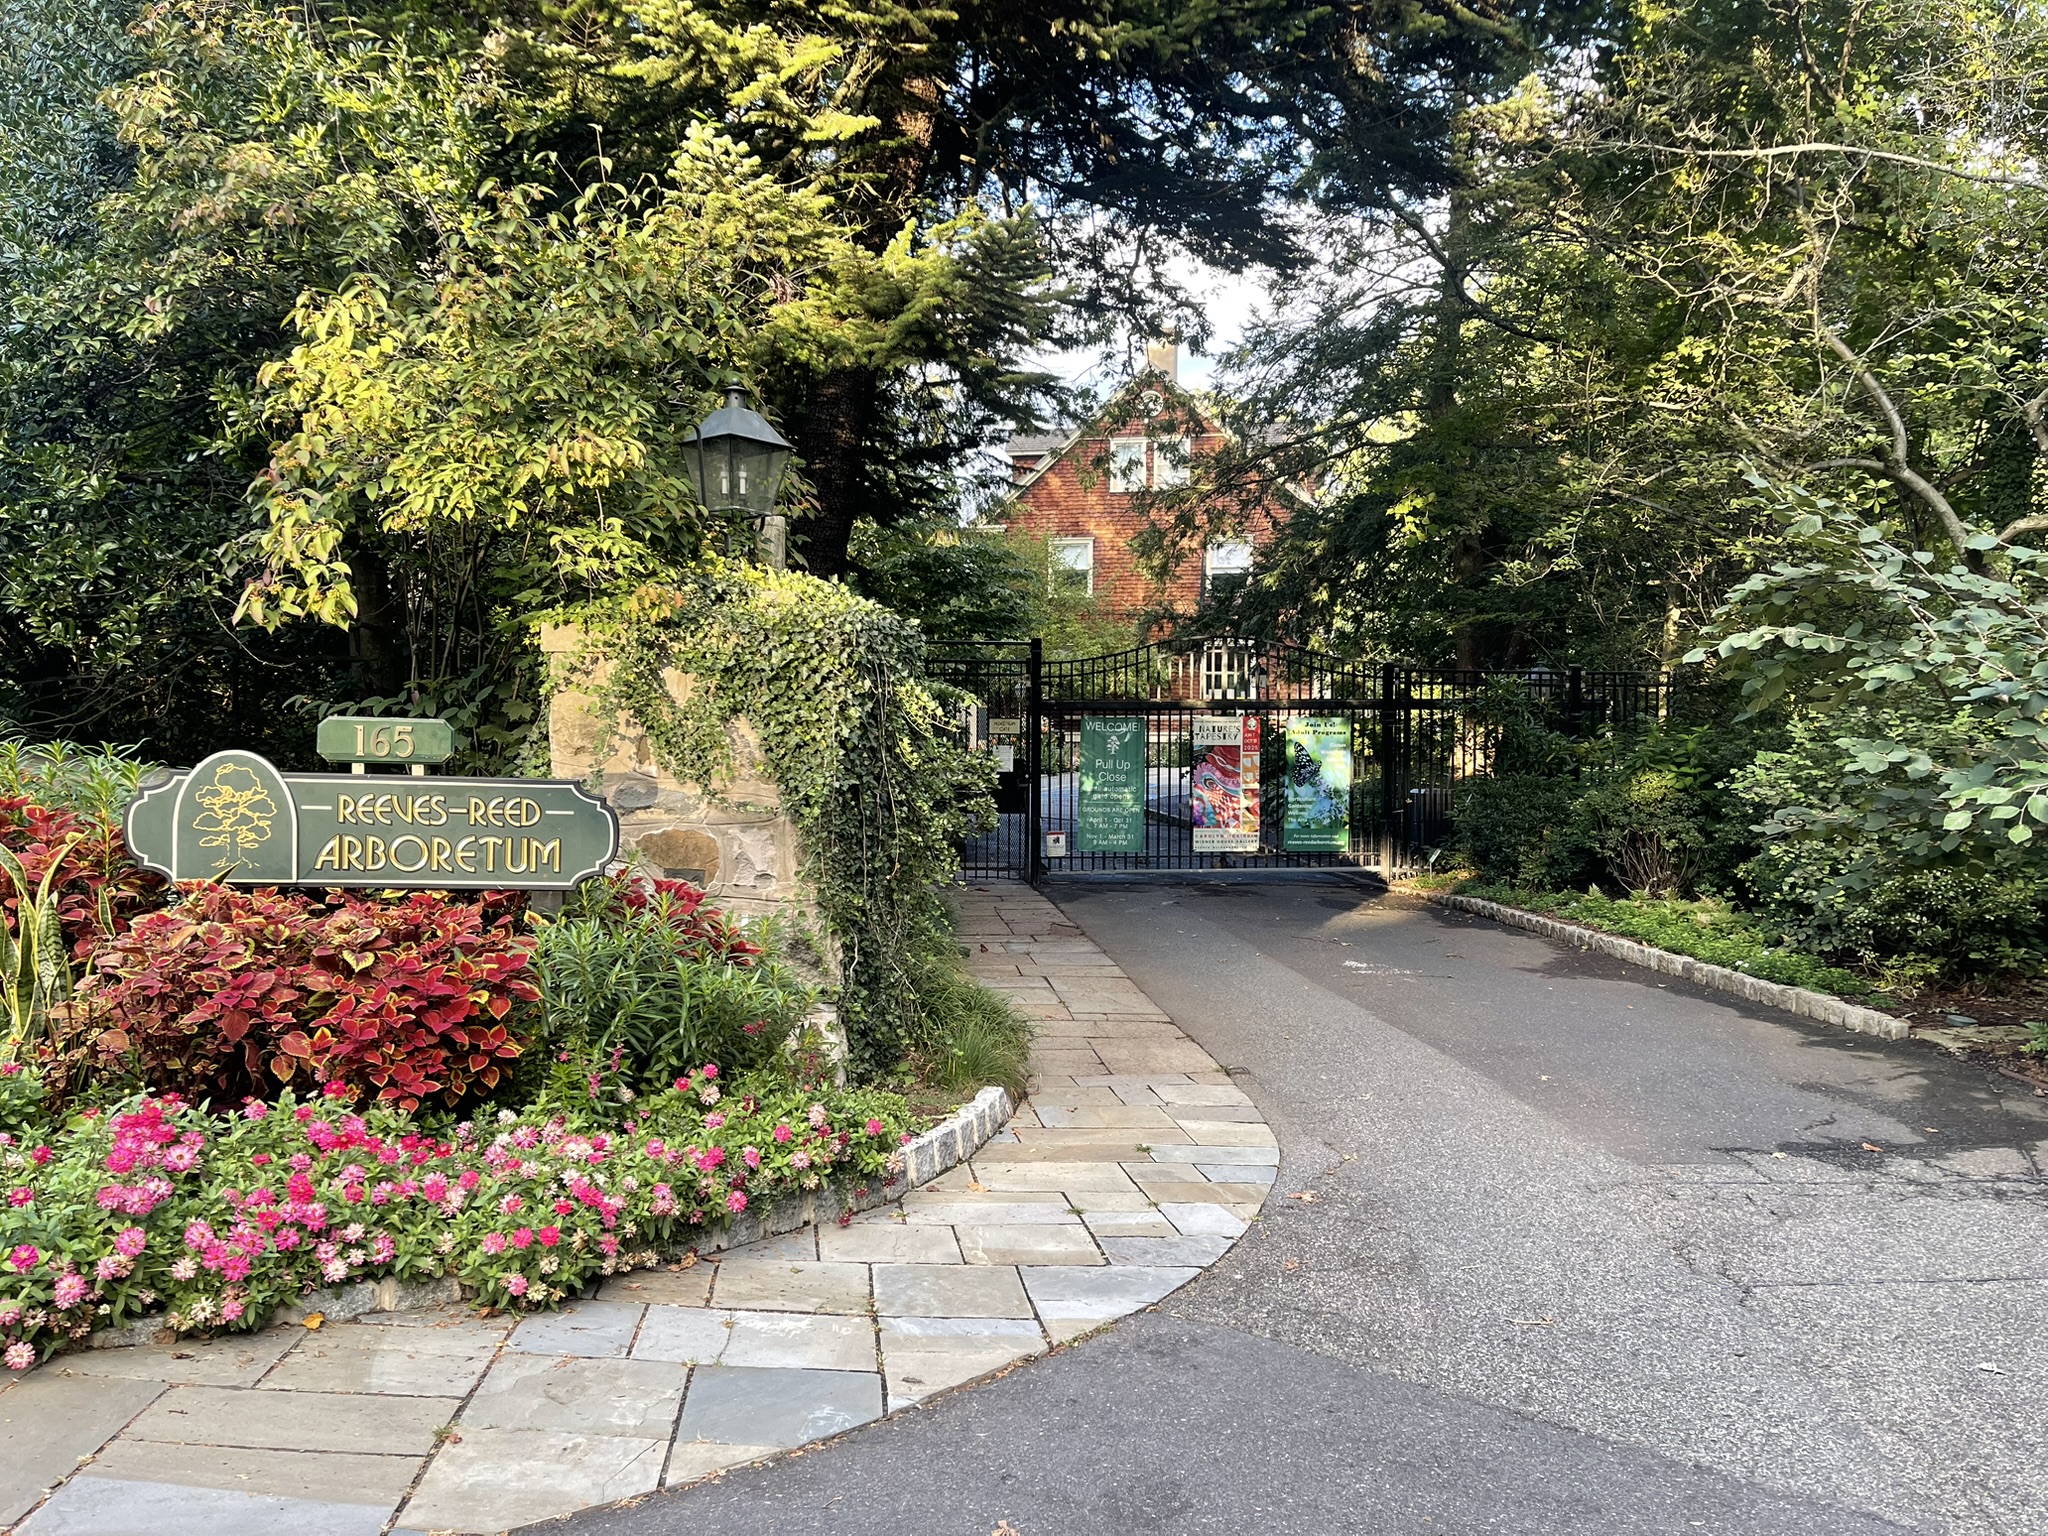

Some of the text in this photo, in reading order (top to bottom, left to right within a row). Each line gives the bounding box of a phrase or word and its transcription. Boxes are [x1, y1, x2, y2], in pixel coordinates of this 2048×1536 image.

[1085, 721, 1141, 732] WELCOME!
[354, 724, 415, 758] 165
[1095, 759, 1131, 771] Pull Up
[1098, 772, 1127, 782] Close
[337, 793, 542, 828] REEVES-REED
[313, 833, 562, 875] ARBORETUM
